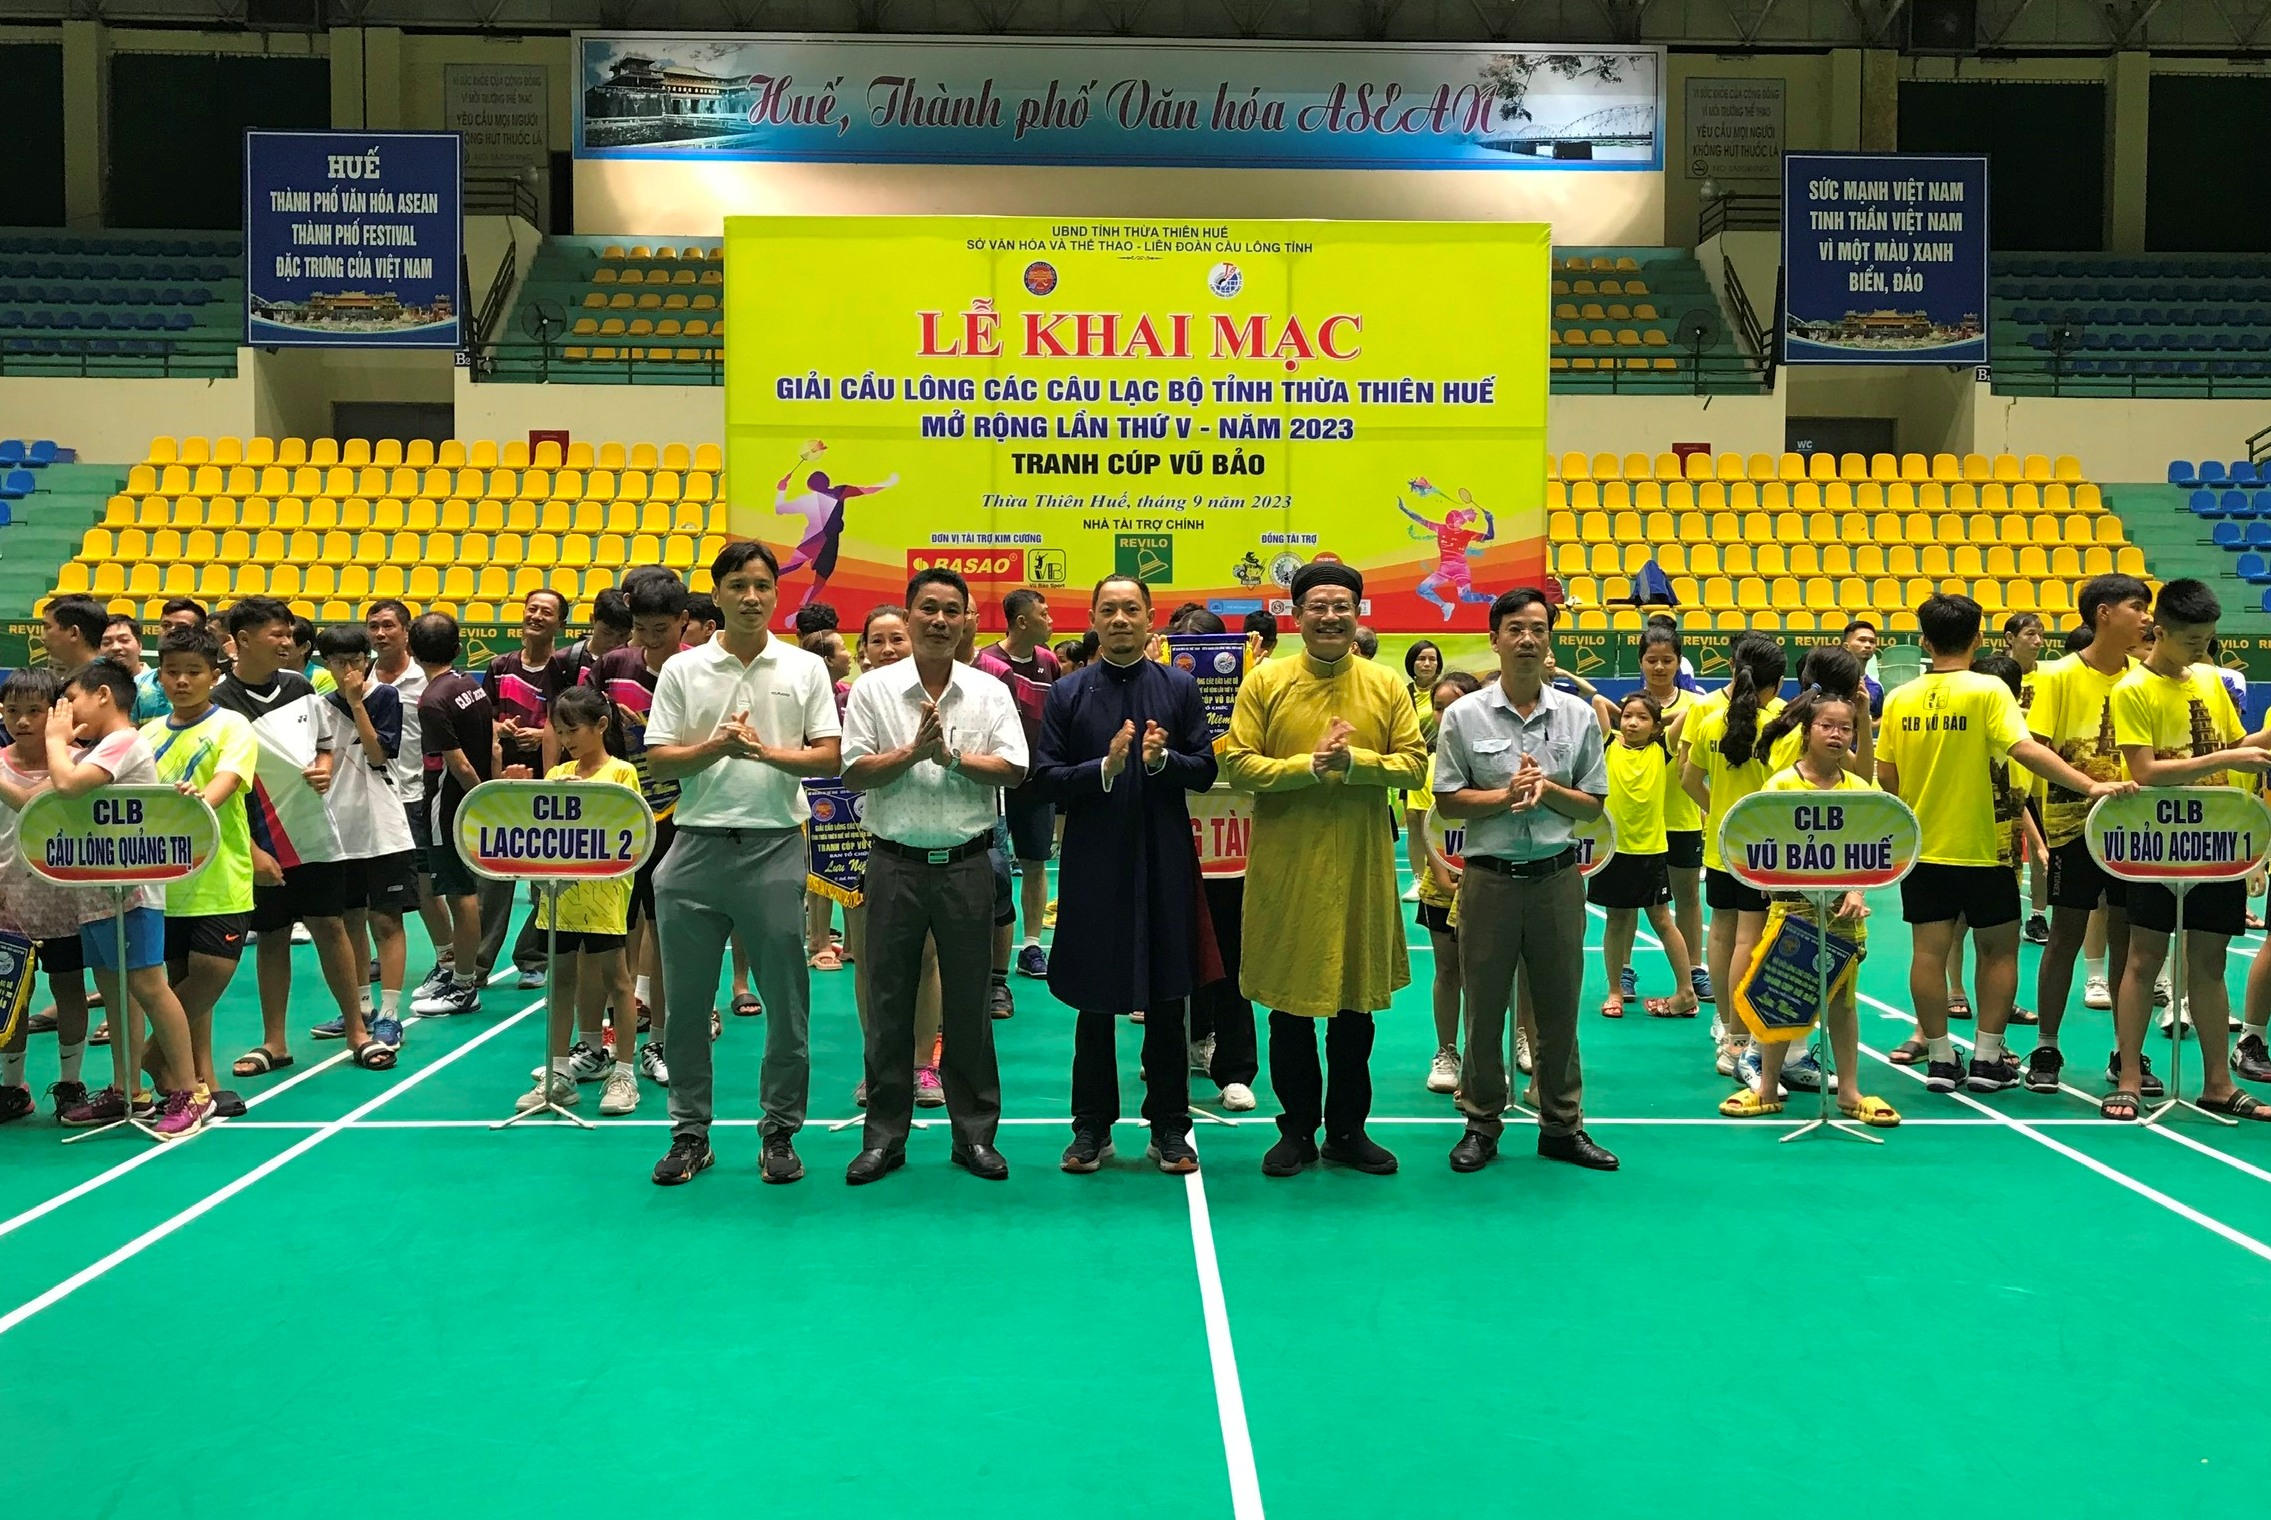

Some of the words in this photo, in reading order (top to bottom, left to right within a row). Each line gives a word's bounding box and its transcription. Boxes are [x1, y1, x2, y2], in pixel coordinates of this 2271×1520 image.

[747, 74, 851, 137] Huế,
[868, 75, 1006, 129] Thành
[1013, 79, 1099, 141] phố
[1104, 79, 1200, 131] Văn
[1211, 80, 1289, 132] hóa
[1298, 81, 1500, 135] ASEAN
[327, 146, 380, 179] HUẾ
[270, 187, 311, 212] THÀNH
[314, 184, 339, 212] PHỐ
[341, 187, 367, 213] VĂN
[370, 188, 395, 213] HÓA
[397, 193, 438, 214] ASEAN
[1809, 177, 1839, 201] SỨC
[1843, 181, 1889, 205] MẠNH
[1893, 178, 1924, 205] VIỆT
[1928, 181, 1964, 202] NAM
[291, 220, 332, 245] THÀNH
[335, 218, 360, 245] PHỐ
[363, 224, 417, 246] FESTIVAL
[1052, 226, 1088, 237] UBND
[1091, 224, 1120, 237] TỈNH
[1123, 224, 1159, 238] THỪA
[1162, 225, 1199, 238] THIÊN
[1809, 211, 1844, 231] TINH
[1848, 205, 1888, 231] THẦN
[1892, 208, 1924, 236] VIỆT
[1927, 212, 1963, 231] NAM
[967, 237, 986, 250] SỞ
[989, 238, 1015, 250] VĂN
[1019, 238, 1047, 250] HÓA
[1050, 238, 1067, 250] VÀ
[1098, 240, 1133, 251] THAO
[1144, 239, 1172, 252] LIÊN
[1176, 239, 1212, 252] ĐOÀN
[1245, 240, 1281, 253] LÔNG
[1284, 241, 1313, 253] TỈNH
[1819, 238, 1833, 261] VÌ
[1837, 238, 1870, 265] MỘT
[1874, 239, 1908, 261] MÀU
[1912, 243, 1954, 262] XANH
[276, 252, 301, 282] ĐẶC
[304, 255, 344, 278] TRƯNG
[347, 251, 372, 278] CỦA
[375, 253, 401, 283] VIỆT
[404, 258, 433, 279] NAM
[1849, 265, 1889, 295] BIỂN,
[1892, 266, 1924, 292] ĐẢO
[917, 298, 1002, 358] LỄ
[1021, 312, 1193, 359] KHAI
[1209, 314, 1363, 372] MẠC
[776, 370, 831, 400] GIẢI
[840, 370, 895, 401] CẦU
[903, 375, 975, 402] LÔNG
[984, 375, 1039, 402] CÁC
[1047, 376, 1101, 403] CÂU
[1114, 380, 1159, 407] LẠC
[1168, 377, 1204, 407] BỘ
[1212, 374, 1274, 403] TỈNH
[1281, 375, 1350, 403] THỪA
[1358, 377, 1434, 404] THIÊN
[1443, 375, 1497, 404] HUẾ
[922, 409, 967, 438] MỞ
[974, 411, 1048, 443] RỘNG
[1057, 409, 1108, 439] LẦN
[1117, 414, 1170, 440] THỨ
[1176, 418, 1193, 439] V
[1219, 414, 1281, 440] NĂM
[1290, 418, 1354, 441] 2023
[1797, 440, 1813, 448] WC
[1011, 453, 1099, 475] TRANH
[1108, 449, 1161, 475] CÚP
[1169, 448, 1203, 475] VŨ
[1212, 447, 1265, 476] BẢO
[982, 494, 1028, 509] Thừa
[1034, 494, 1084, 509] Thiên
[1090, 491, 1131, 511] Huế,
[1137, 494, 1187, 512] tháng
[1192, 496, 1203, 509] 9
[1207, 495, 1245, 509] năm
[1250, 495, 1293, 509] 2023
[1083, 517, 1109, 529] NHÀ
[1113, 517, 1132, 529] TÀI
[1136, 519, 1163, 532] TRỢ
[1166, 517, 1204, 529] CHÍNH
[931, 533, 949, 543] ĐƠN
[951, 534, 960, 544] VỊ
[961, 532, 974, 543] TÀI
[977, 534, 993, 545] TRỢ
[995, 534, 1011, 543] KIM
[1013, 533, 1042, 543] CƯƠNG
[1120, 538, 1168, 548] REVILO
[1261, 532, 1284, 544] ĐỒNG
[1286, 533, 1300, 544] TÀI
[1302, 534, 1318, 545] TRỢ
[932, 557, 1010, 574] BASAO
[459, 628, 497, 638] EVILO
[1559, 635, 1605, 646] REVILO
[1683, 636, 1729, 646] REVILO
[1795, 636, 1841, 646] REVILO
[1902, 716, 1920, 731] CLB
[1943, 713, 1967, 731] BẢO
[93, 799, 144, 825] CLB
[533, 795, 582, 821] CLB
[1794, 806, 1844, 831] CLB
[2157, 800, 2203, 824] CLB
[46, 828, 74, 867] CẦU
[78, 832, 115, 866] LÔNG
[118, 828, 166, 868] QUẢNG
[170, 836, 192, 872] TRỊ
[479, 827, 611, 860] LACCCUEIL
[618, 830, 633, 861] 2
[1746, 837, 1777, 869] VŨ
[1786, 834, 1835, 870] BẢO
[1844, 834, 1894, 870] HUẾ
[2103, 826, 2125, 861] VŨ
[2130, 821, 2163, 862] BẢO
[2168, 831, 2238, 862] ACDEMY
[2243, 832, 2252, 862] 1
